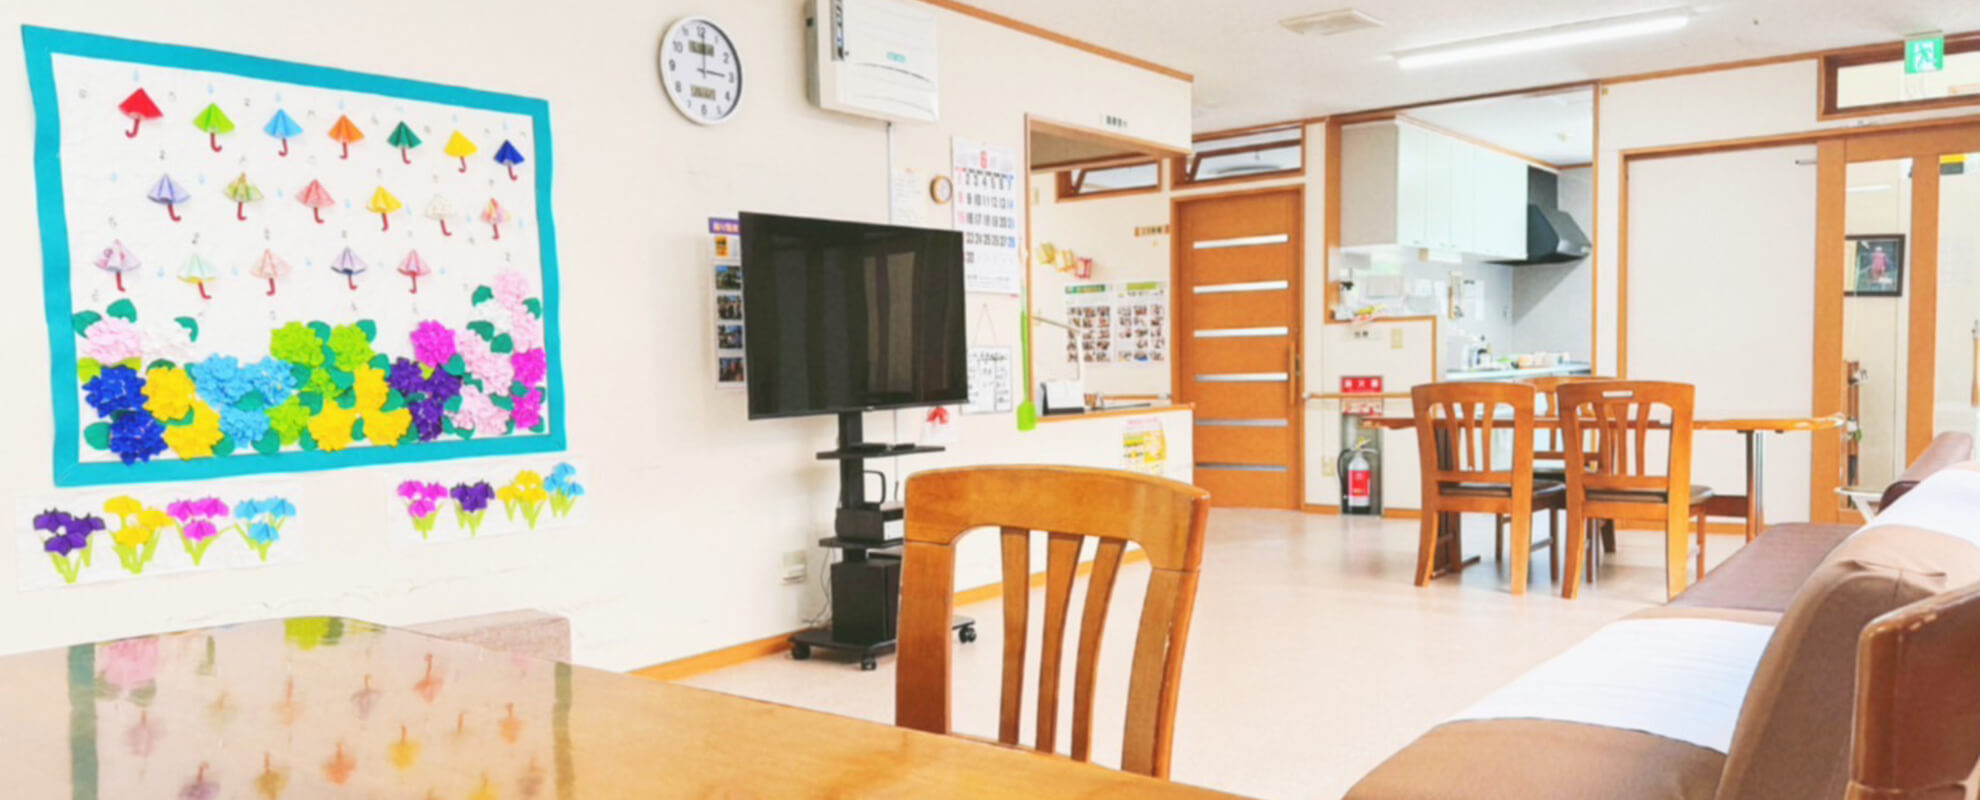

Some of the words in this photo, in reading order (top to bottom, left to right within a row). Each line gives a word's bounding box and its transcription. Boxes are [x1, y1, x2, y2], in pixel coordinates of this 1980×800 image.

[696, 26, 706, 38] 12
[672, 41, 683, 54] 10
[723, 52, 729, 64] 2
[668, 59, 676, 71] 9
[728, 71, 735, 84] 3
[967, 192, 972, 205] 9
[974, 194, 981, 206] 10
[983, 195, 990, 207] 11
[991, 196, 997, 208] 12
[974, 213, 982, 225] 17
